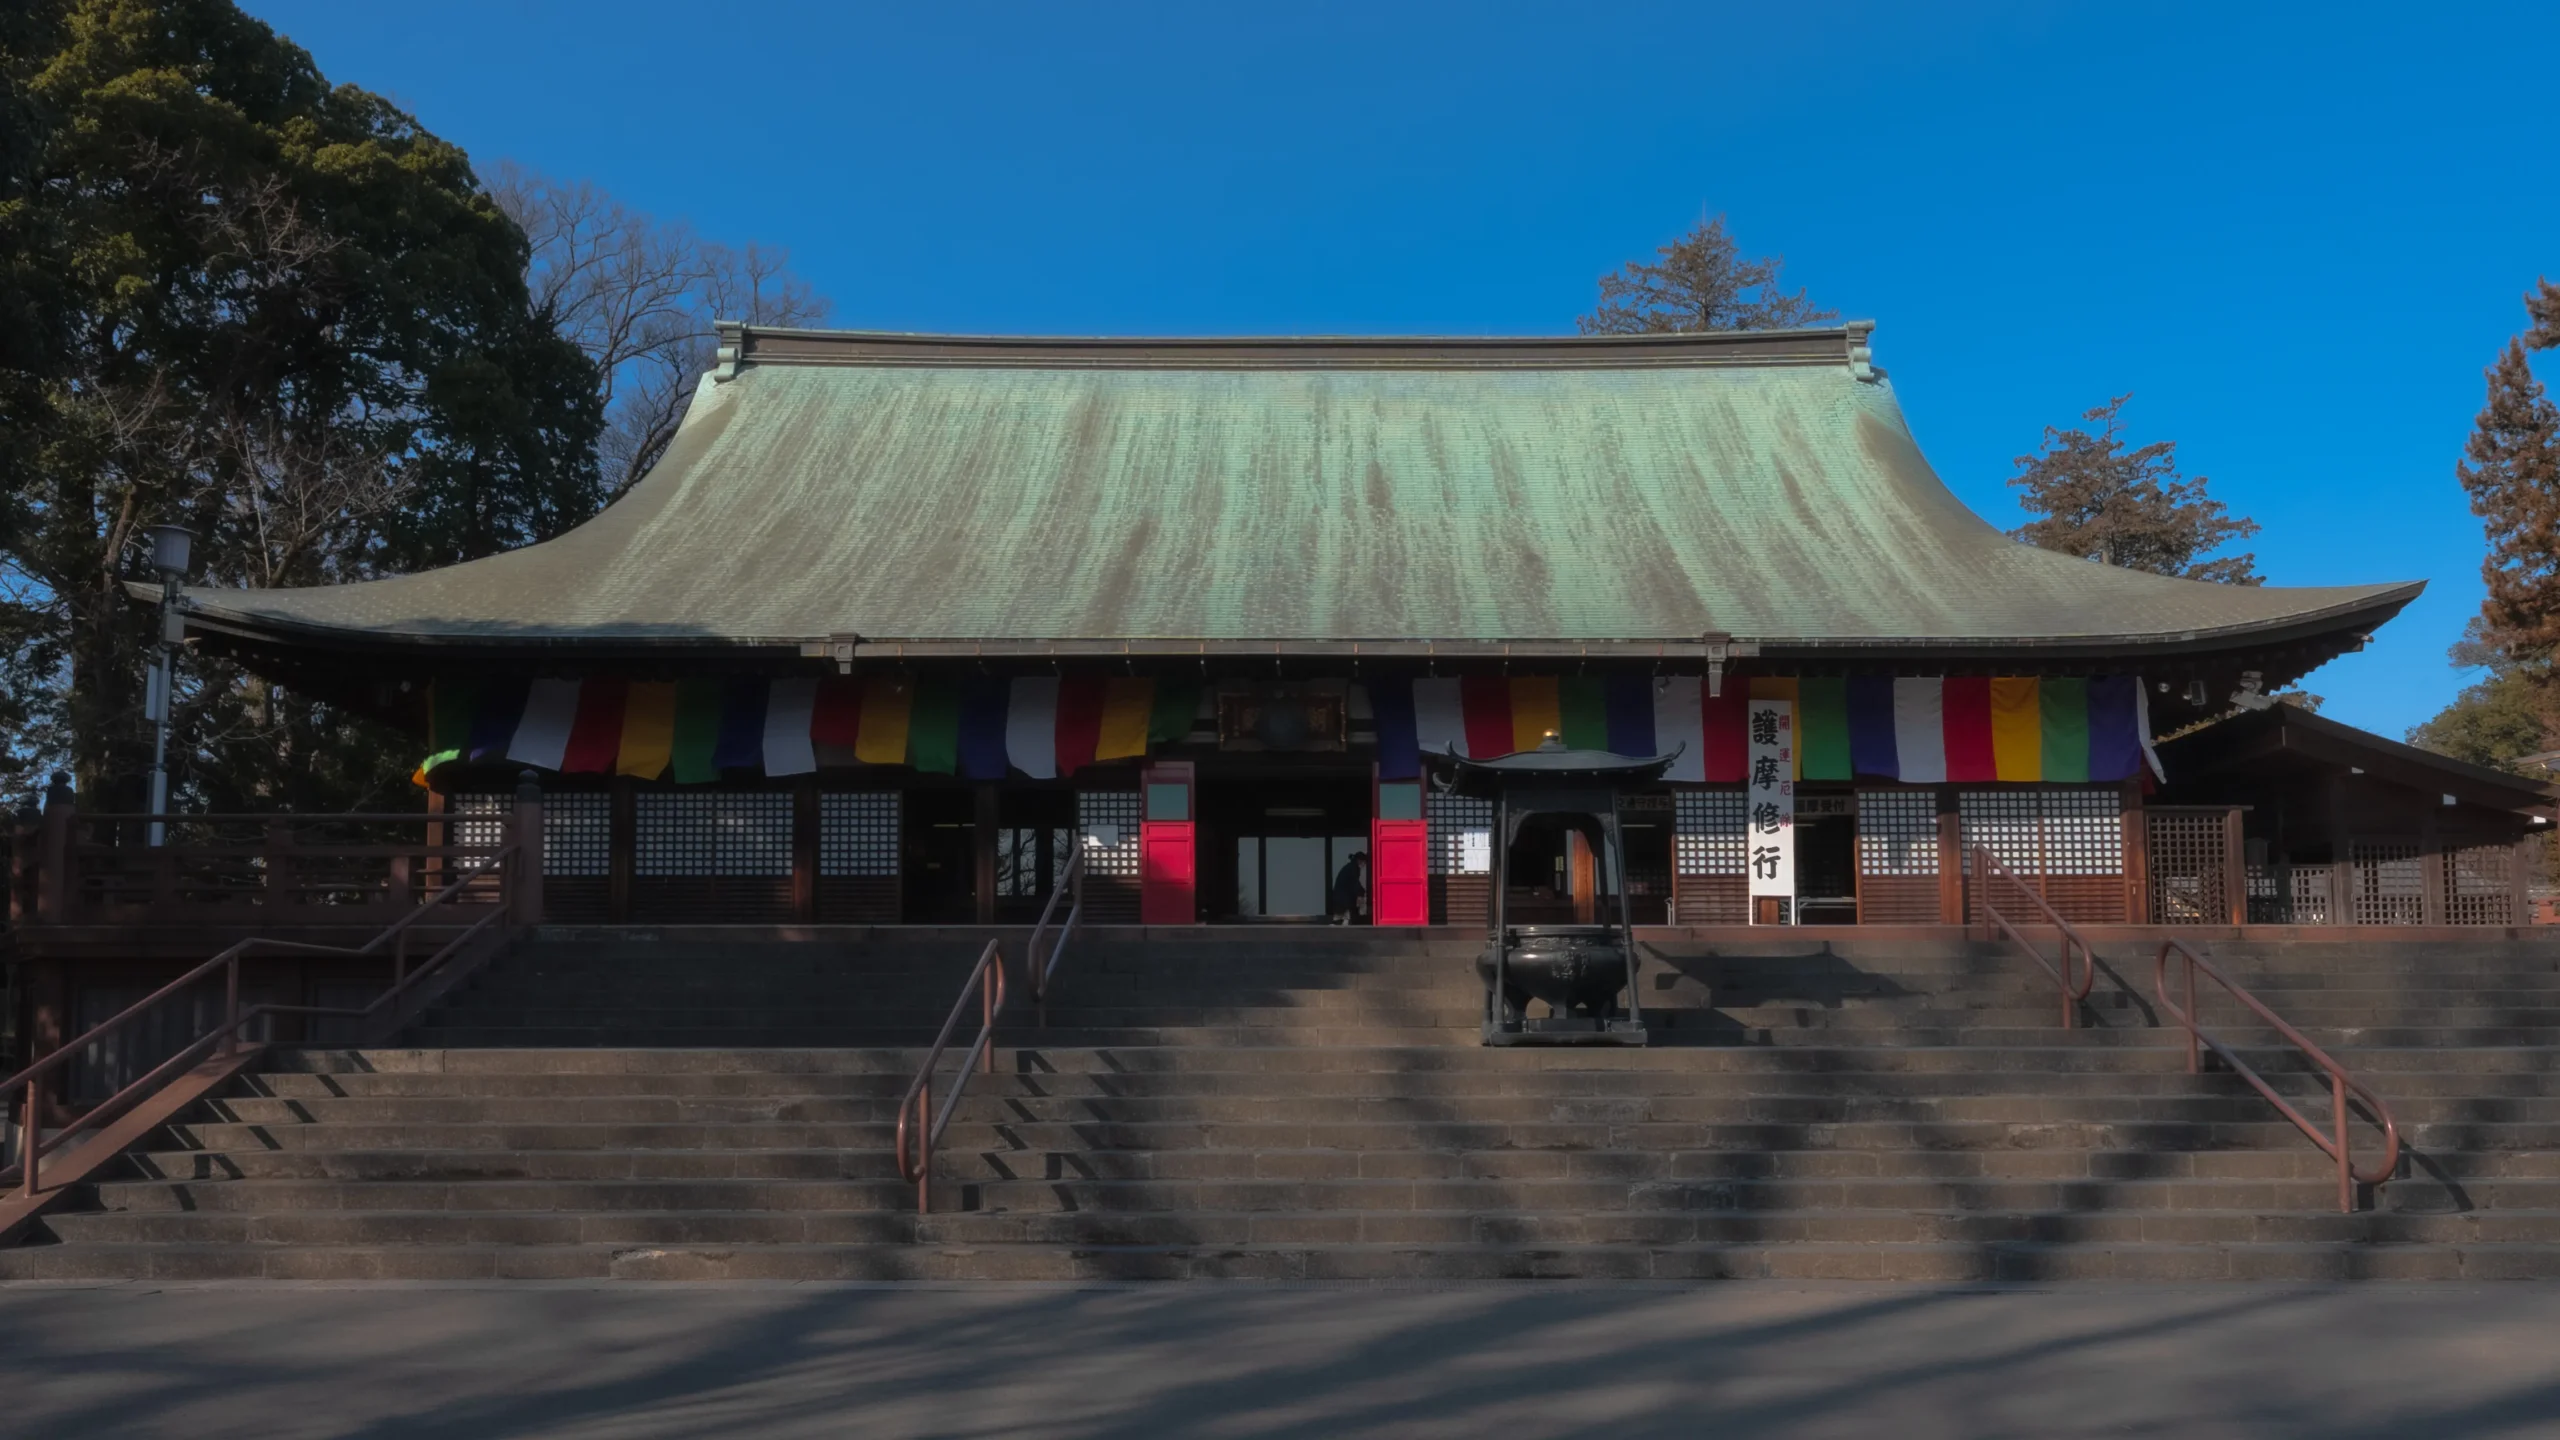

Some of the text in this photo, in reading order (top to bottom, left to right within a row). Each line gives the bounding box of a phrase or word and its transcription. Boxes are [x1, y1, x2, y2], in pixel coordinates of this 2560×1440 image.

[1752, 709, 1782, 880] 護摩修行
[1779, 715, 1792, 828] 開運厄除
